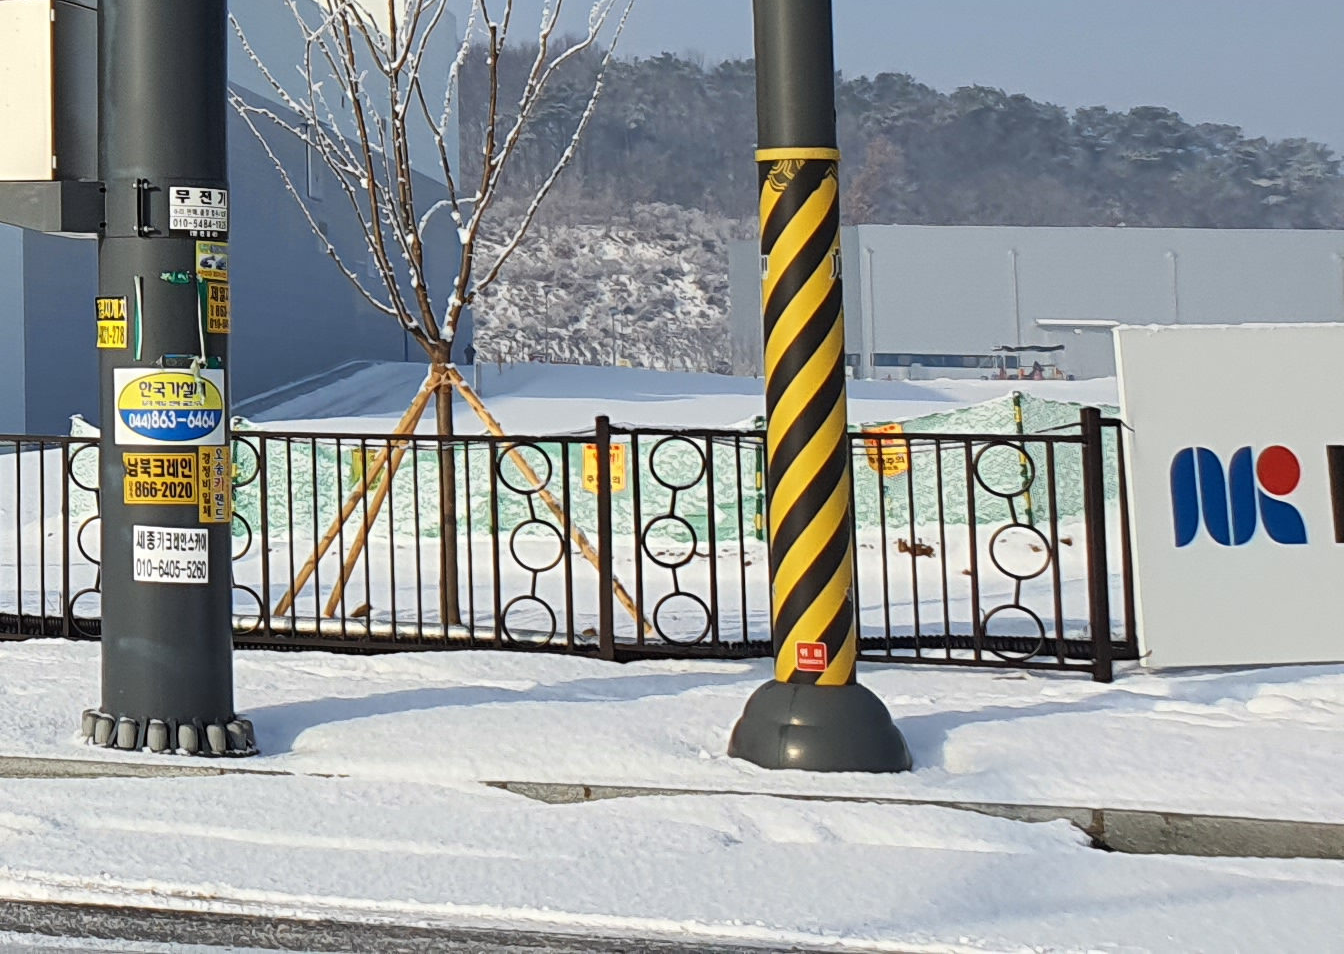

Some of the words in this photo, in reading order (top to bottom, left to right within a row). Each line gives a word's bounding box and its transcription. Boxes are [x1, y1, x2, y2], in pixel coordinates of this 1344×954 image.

[128, 410, 215, 430] 044)863-6464
[127, 457, 193, 479] 남북크레인
[135, 480, 193, 499] 866-2020
[136, 557, 207, 580] 010-6405-5260
